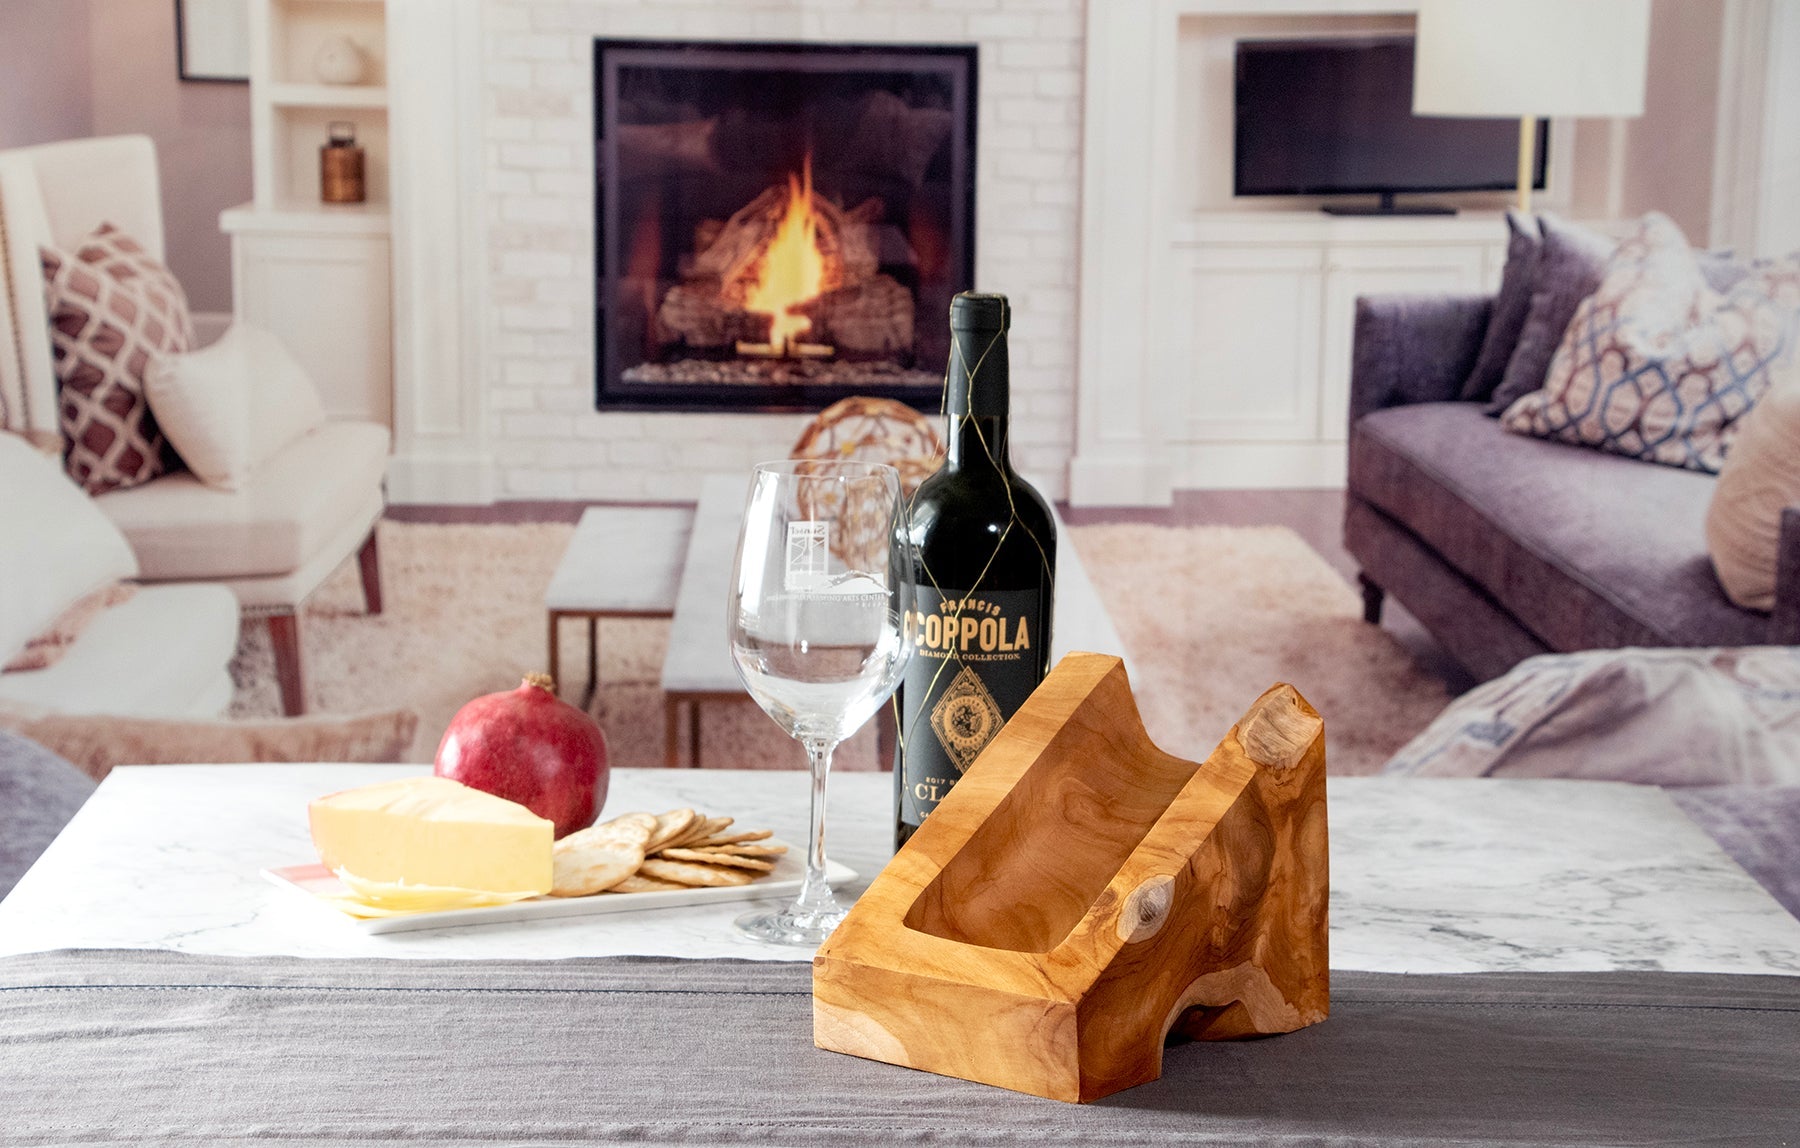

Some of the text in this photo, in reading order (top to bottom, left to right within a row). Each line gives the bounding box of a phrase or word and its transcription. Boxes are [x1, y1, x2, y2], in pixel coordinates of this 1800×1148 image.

[939, 598, 1001, 616] FRANCIS
[919, 649, 960, 660] DIAMOND
[925, 776, 946, 785] 2017
[914, 783, 945, 802] CL
